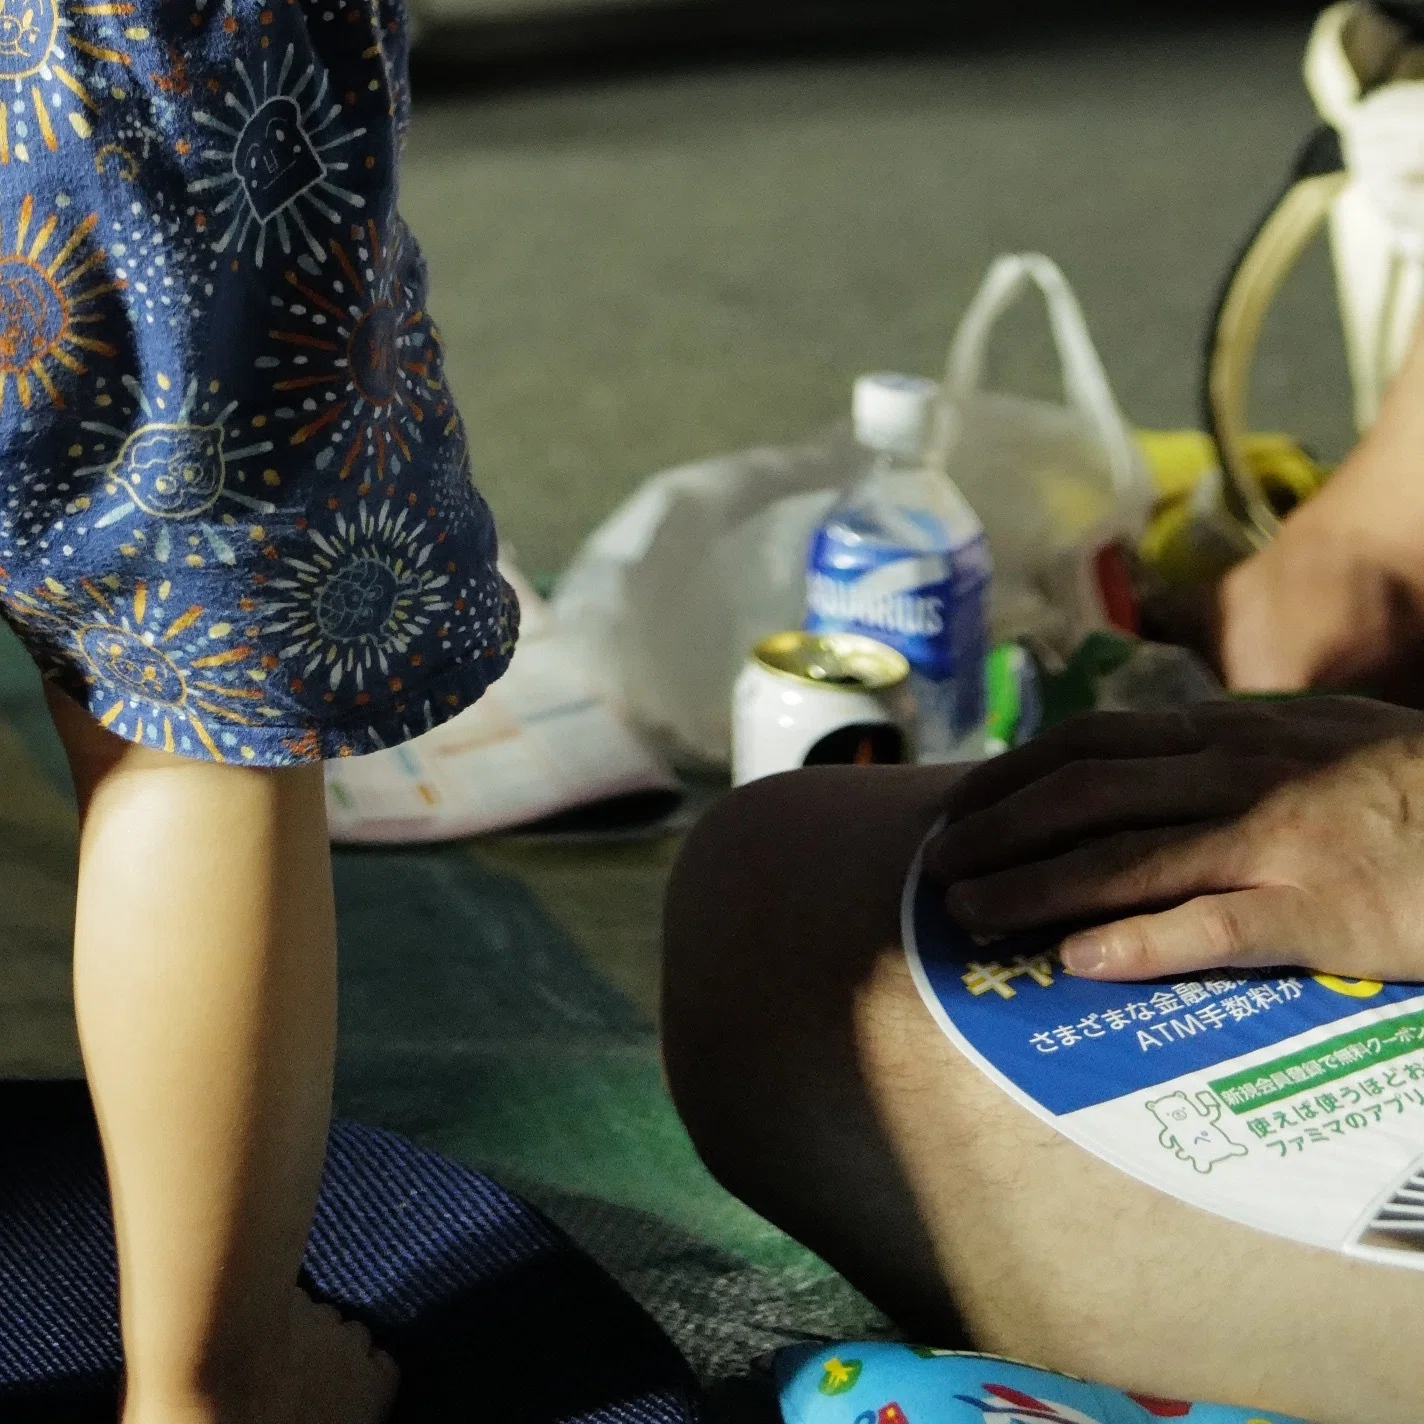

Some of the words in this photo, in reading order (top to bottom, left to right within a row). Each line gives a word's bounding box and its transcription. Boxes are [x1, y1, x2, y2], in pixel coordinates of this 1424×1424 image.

[960, 954, 1076, 1001] キャ
[1029, 966, 1248, 1053] さまざまな金融機
[1135, 975, 1304, 1052] ATM手数料が
